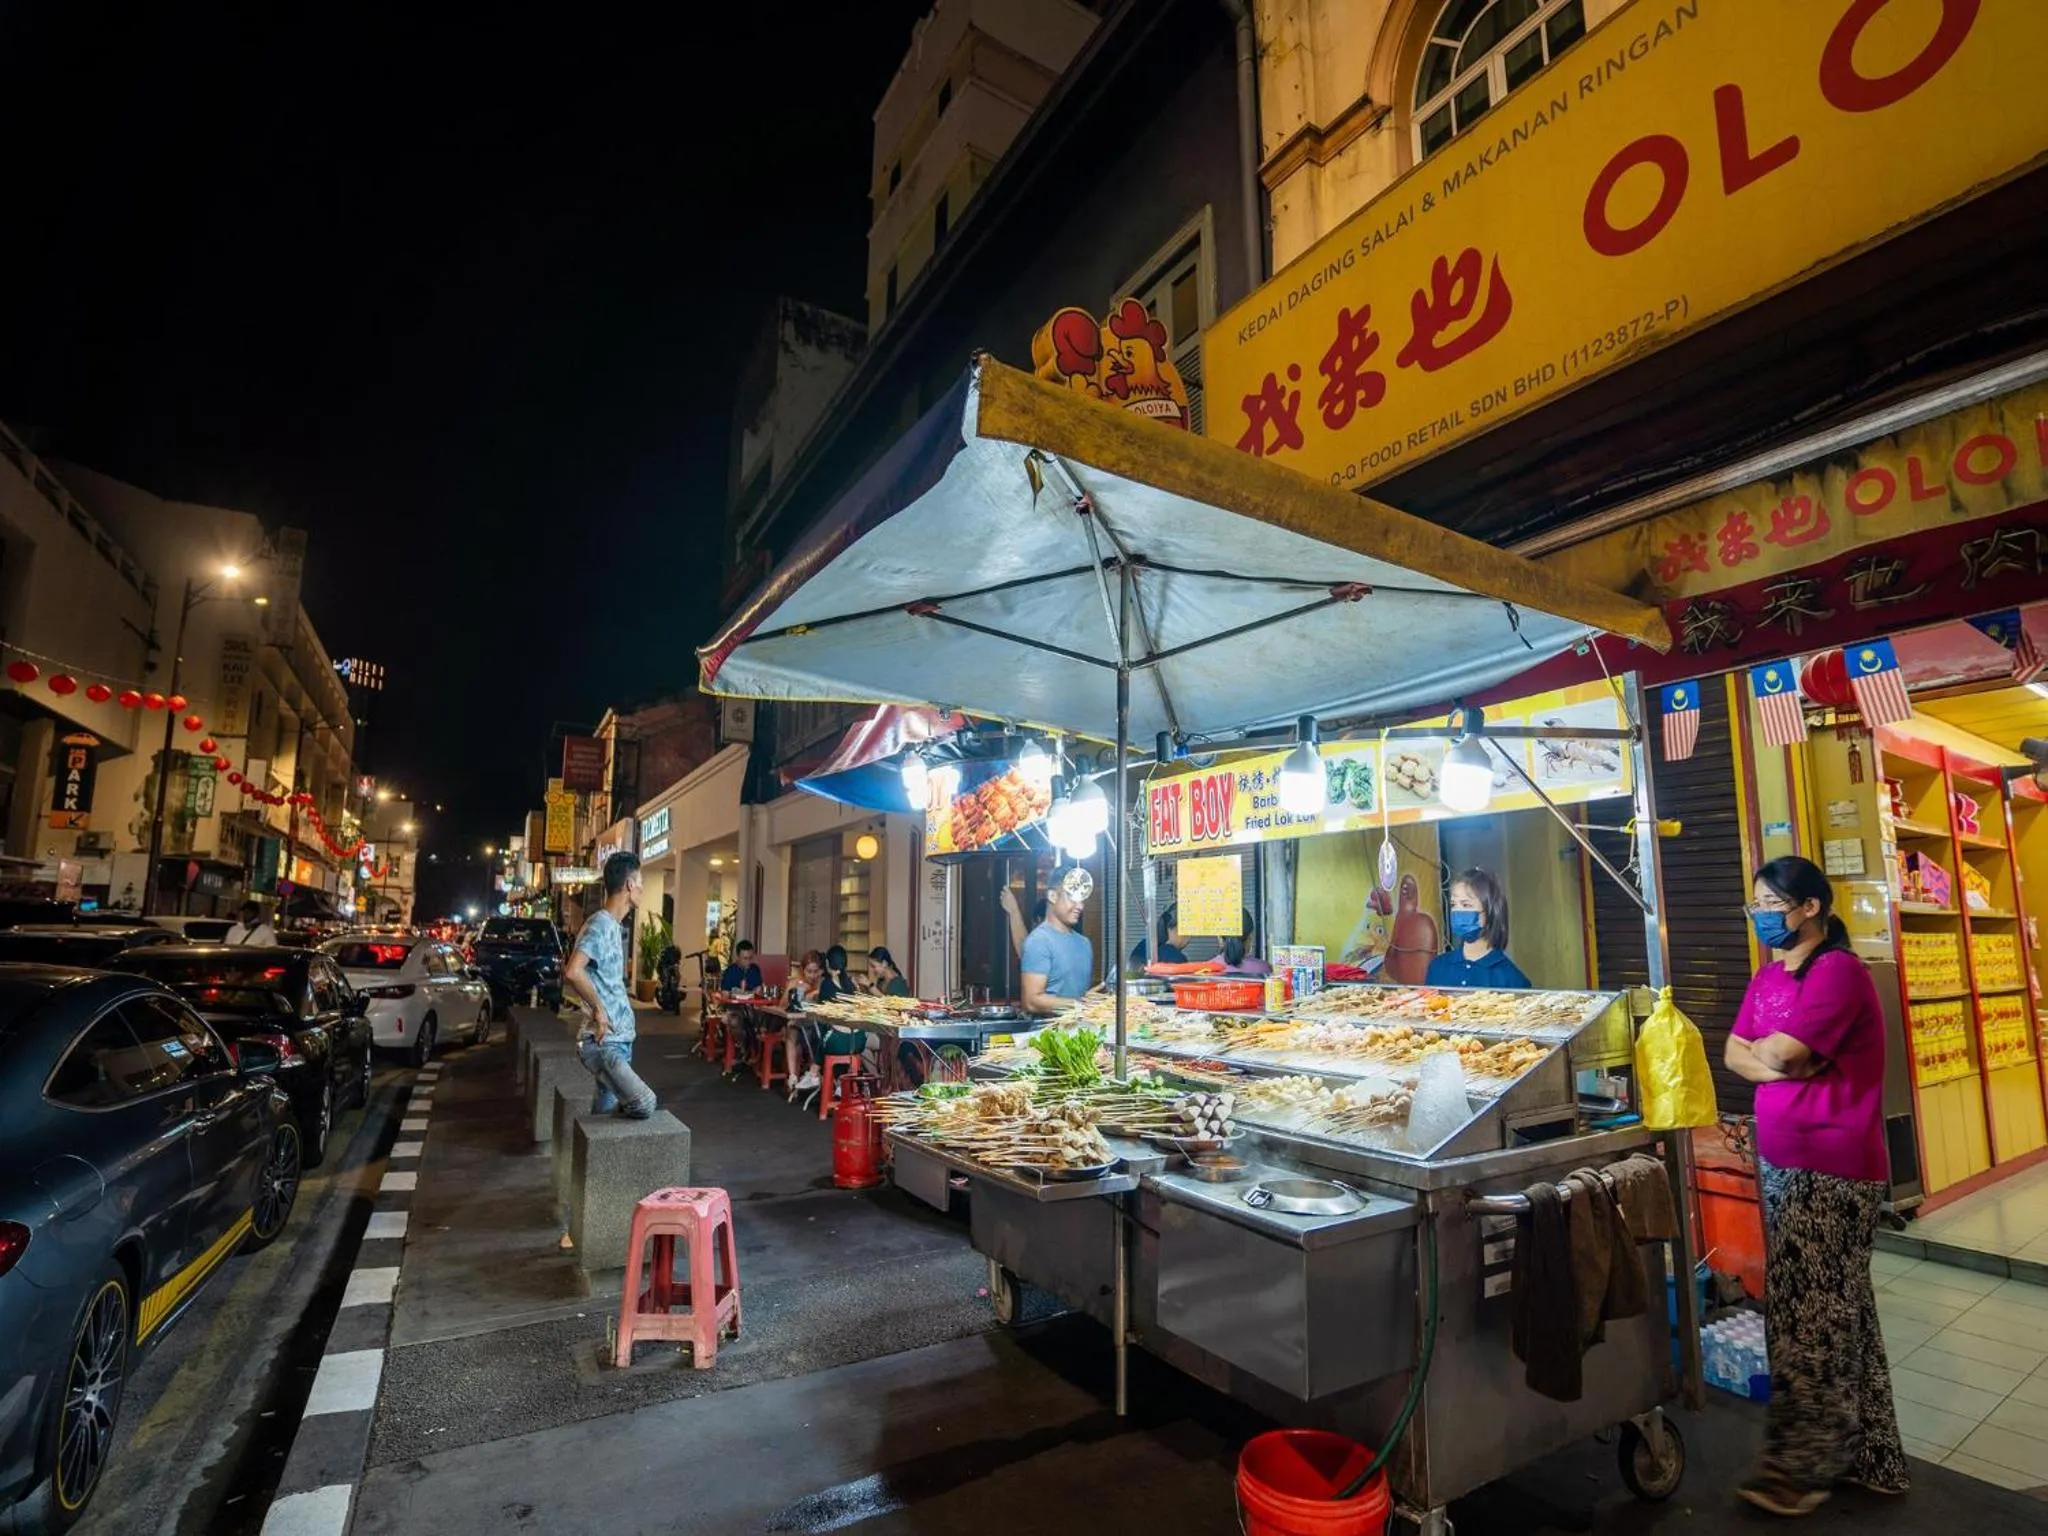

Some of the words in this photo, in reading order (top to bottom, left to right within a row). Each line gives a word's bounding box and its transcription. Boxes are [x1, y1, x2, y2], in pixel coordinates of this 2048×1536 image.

[1237, 302, 1283, 346] KEDAI
[1287, 249, 1356, 311] DAGING
[1360, 205, 1415, 257] SALAI
[1421, 192, 1436, 212] &
[1442, 91, 1569, 198] MAKANAN
[1577, 0, 1700, 100] RINGAN
[1359, 439, 1403, 475] FOOD
[1407, 409, 1465, 449] RETAIL
[1470, 385, 1508, 419] SDN
[1513, 362, 1556, 398] BHD
[1561, 294, 1690, 379] (1123872-P)
[64, 756, 83, 810] PARK
[1150, 783, 1182, 847] FAT
[1188, 771, 1235, 841] BOY
[1252, 793, 1278, 809] Barb
[1245, 812, 1271, 830] Fried
[1274, 811, 1293, 826] Lok
